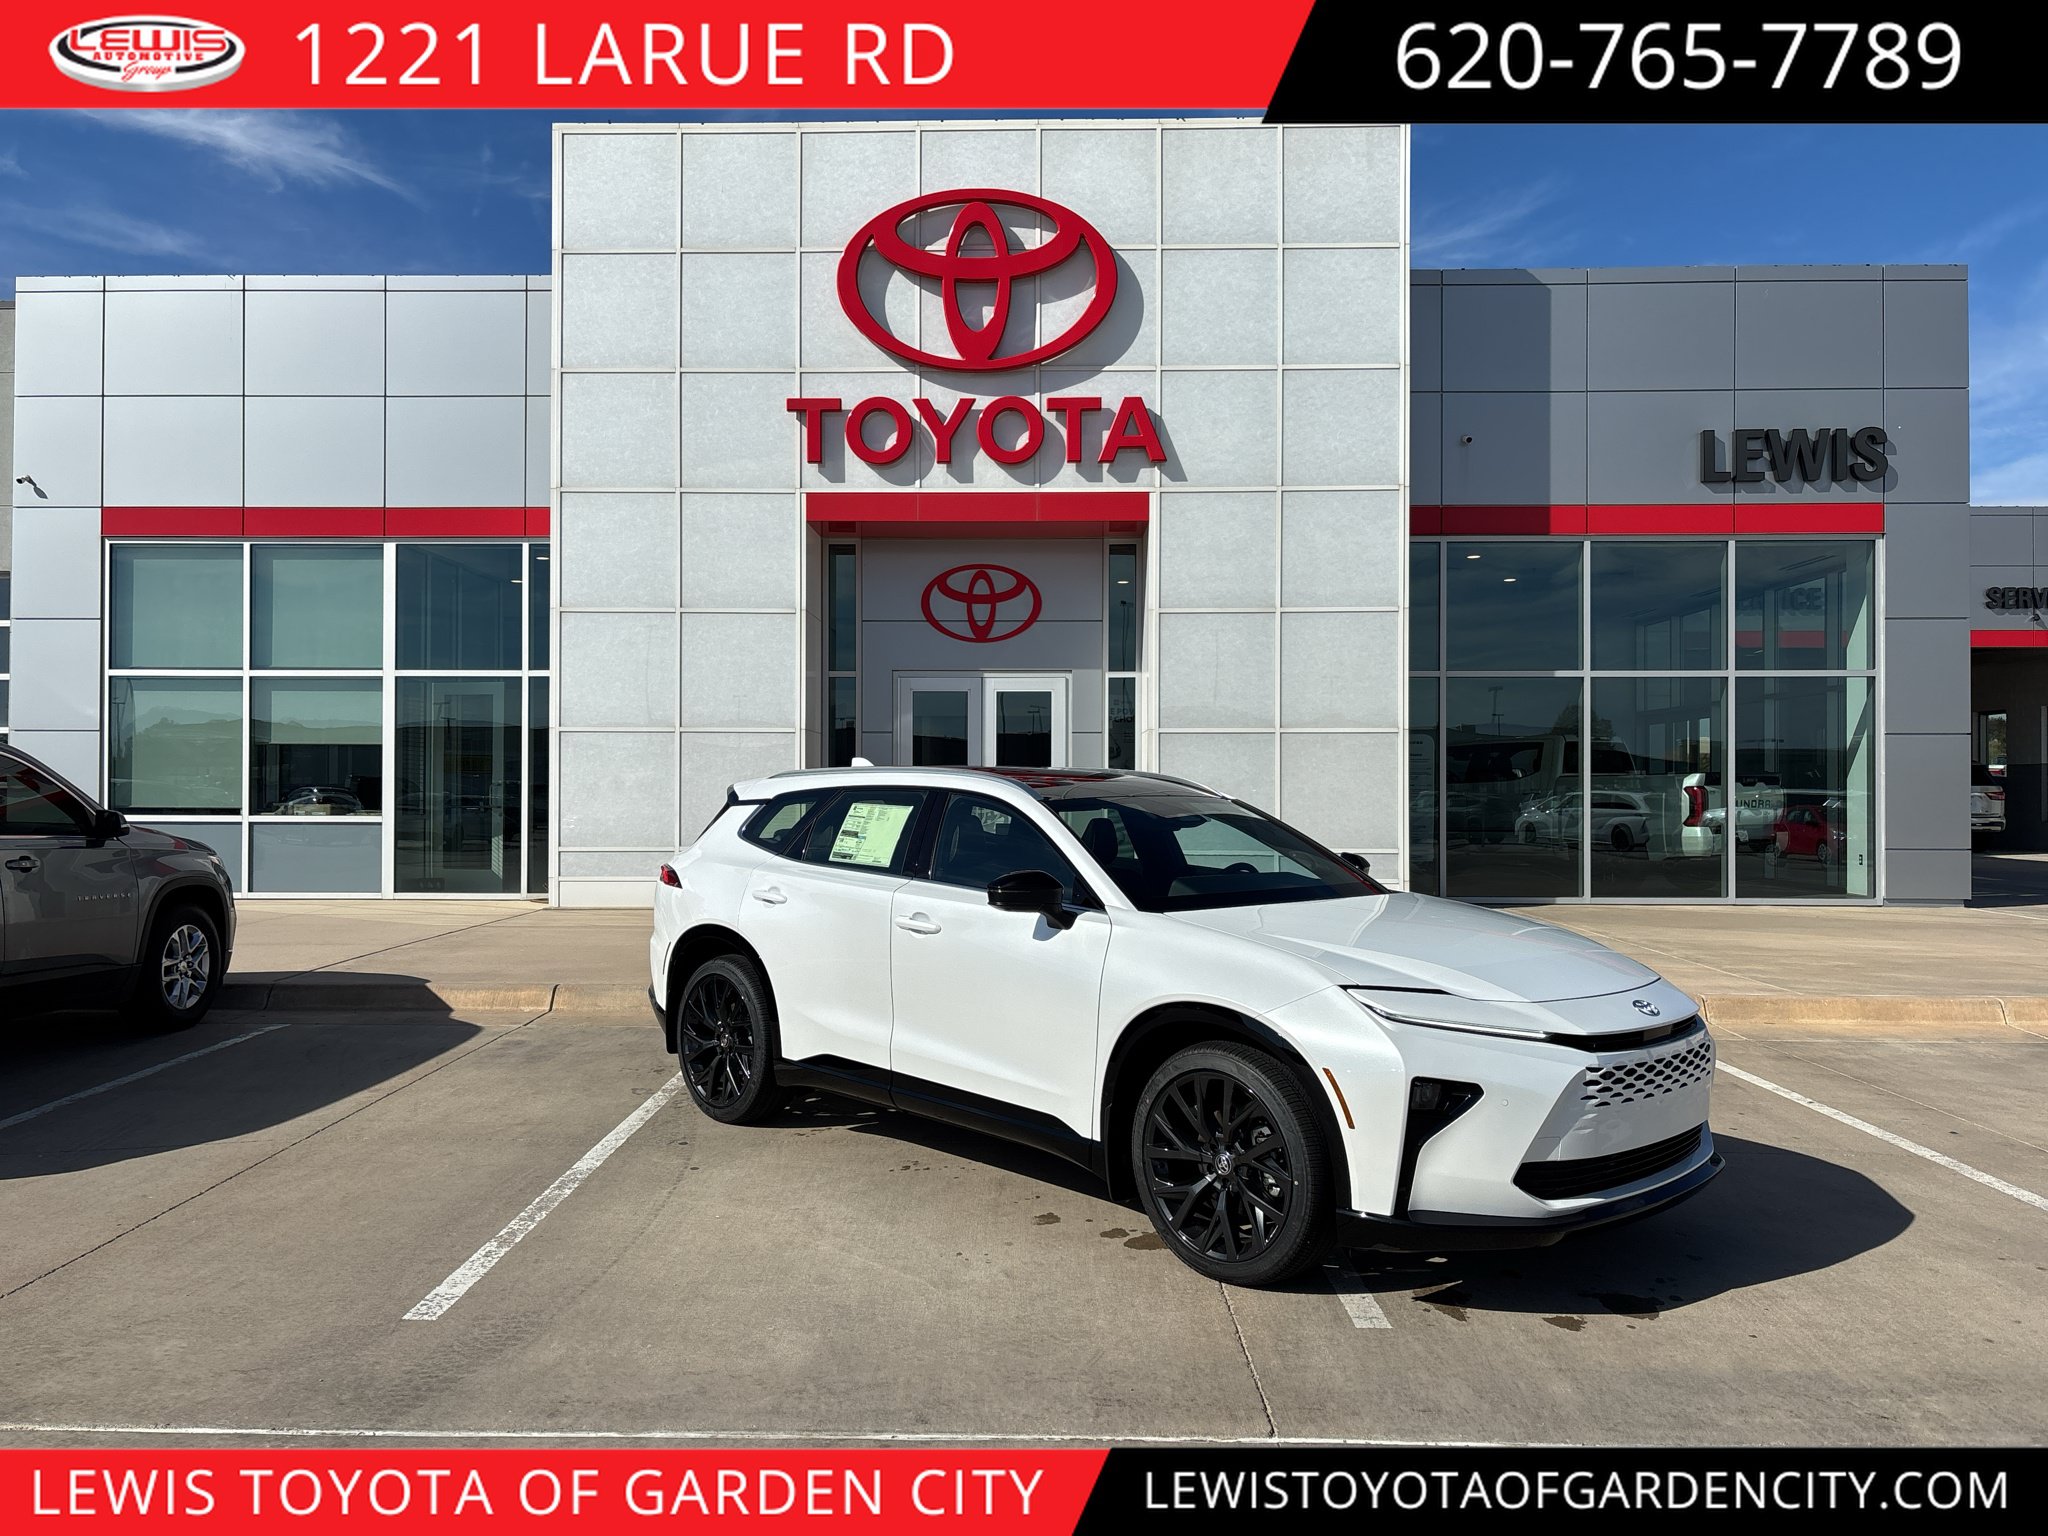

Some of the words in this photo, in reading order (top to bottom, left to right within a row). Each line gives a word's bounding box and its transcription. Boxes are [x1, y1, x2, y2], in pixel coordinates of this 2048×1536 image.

[786, 395, 1168, 464] TOYOTA
[1701, 426, 1889, 483] LEWIS
[1735, 799, 1771, 808] UNDRA
